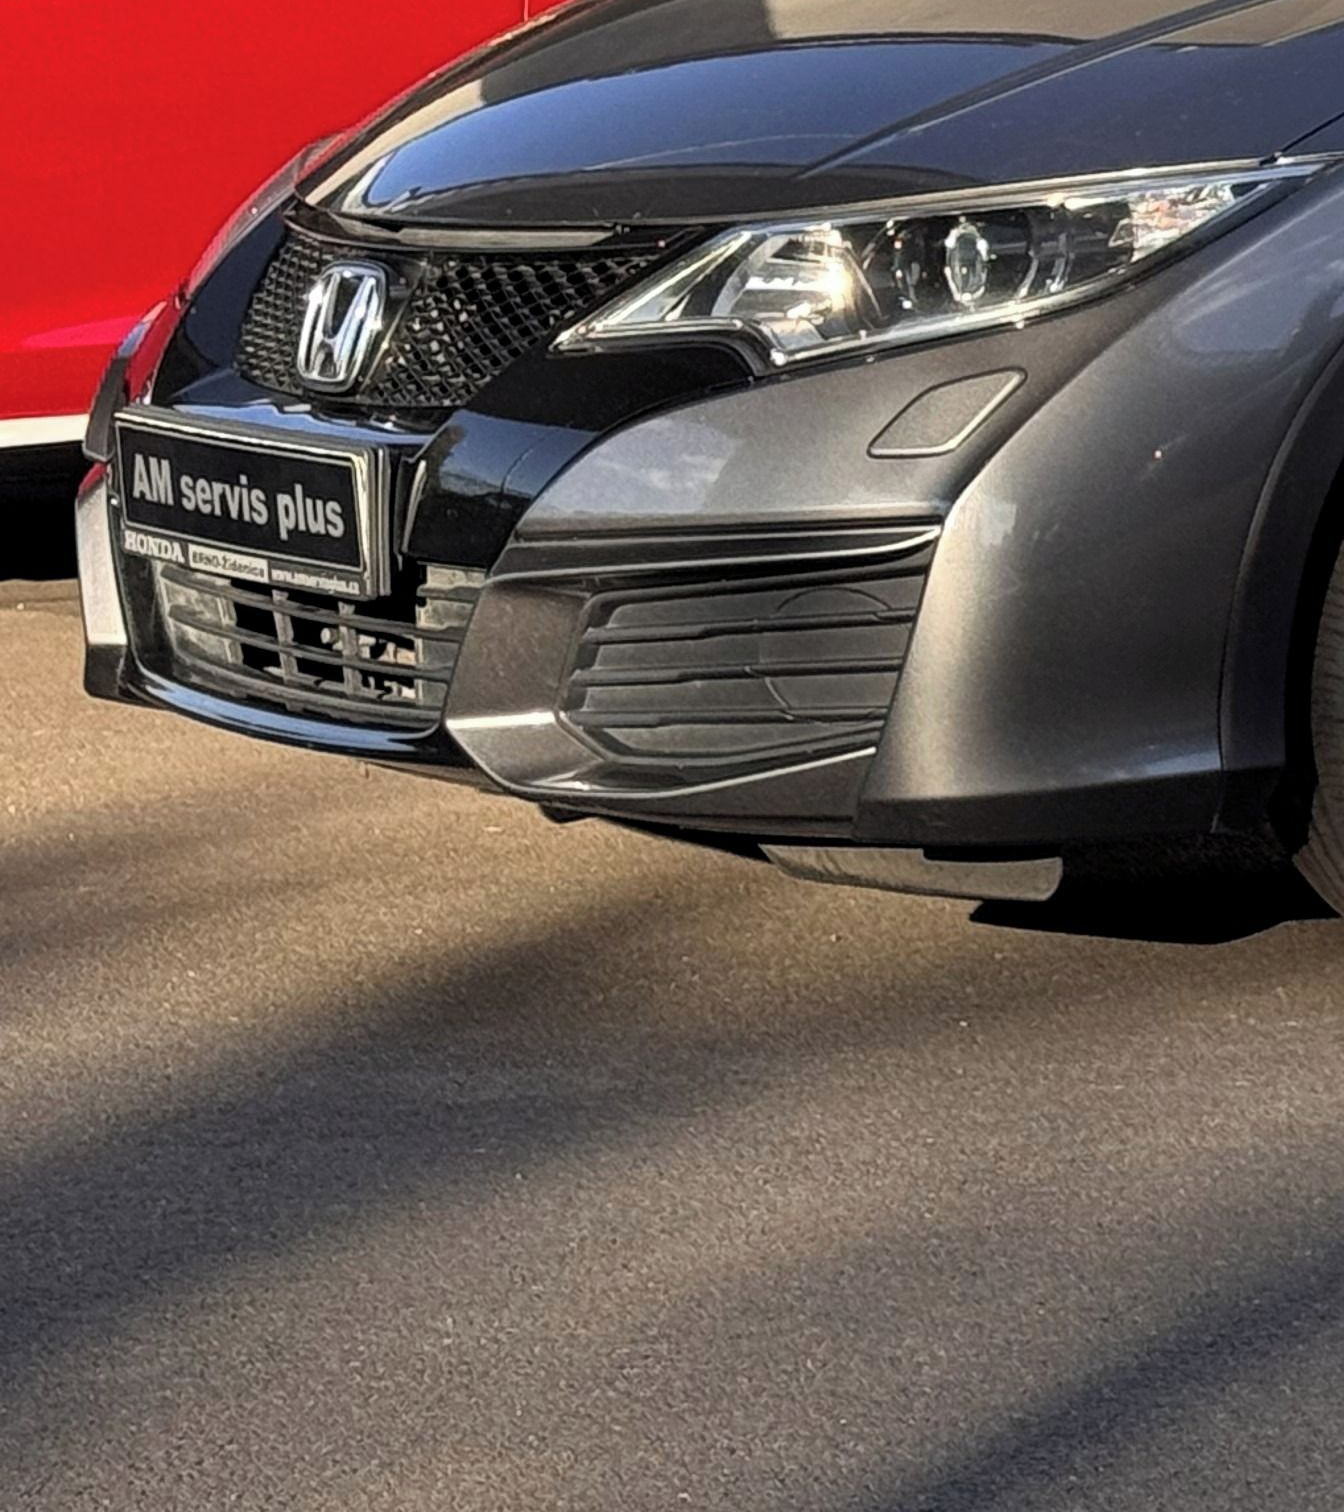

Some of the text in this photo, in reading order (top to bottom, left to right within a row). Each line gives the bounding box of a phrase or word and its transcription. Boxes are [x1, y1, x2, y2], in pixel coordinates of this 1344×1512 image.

[132, 453, 346, 541] AM servis plus
[124, 530, 186, 564] HONDA
